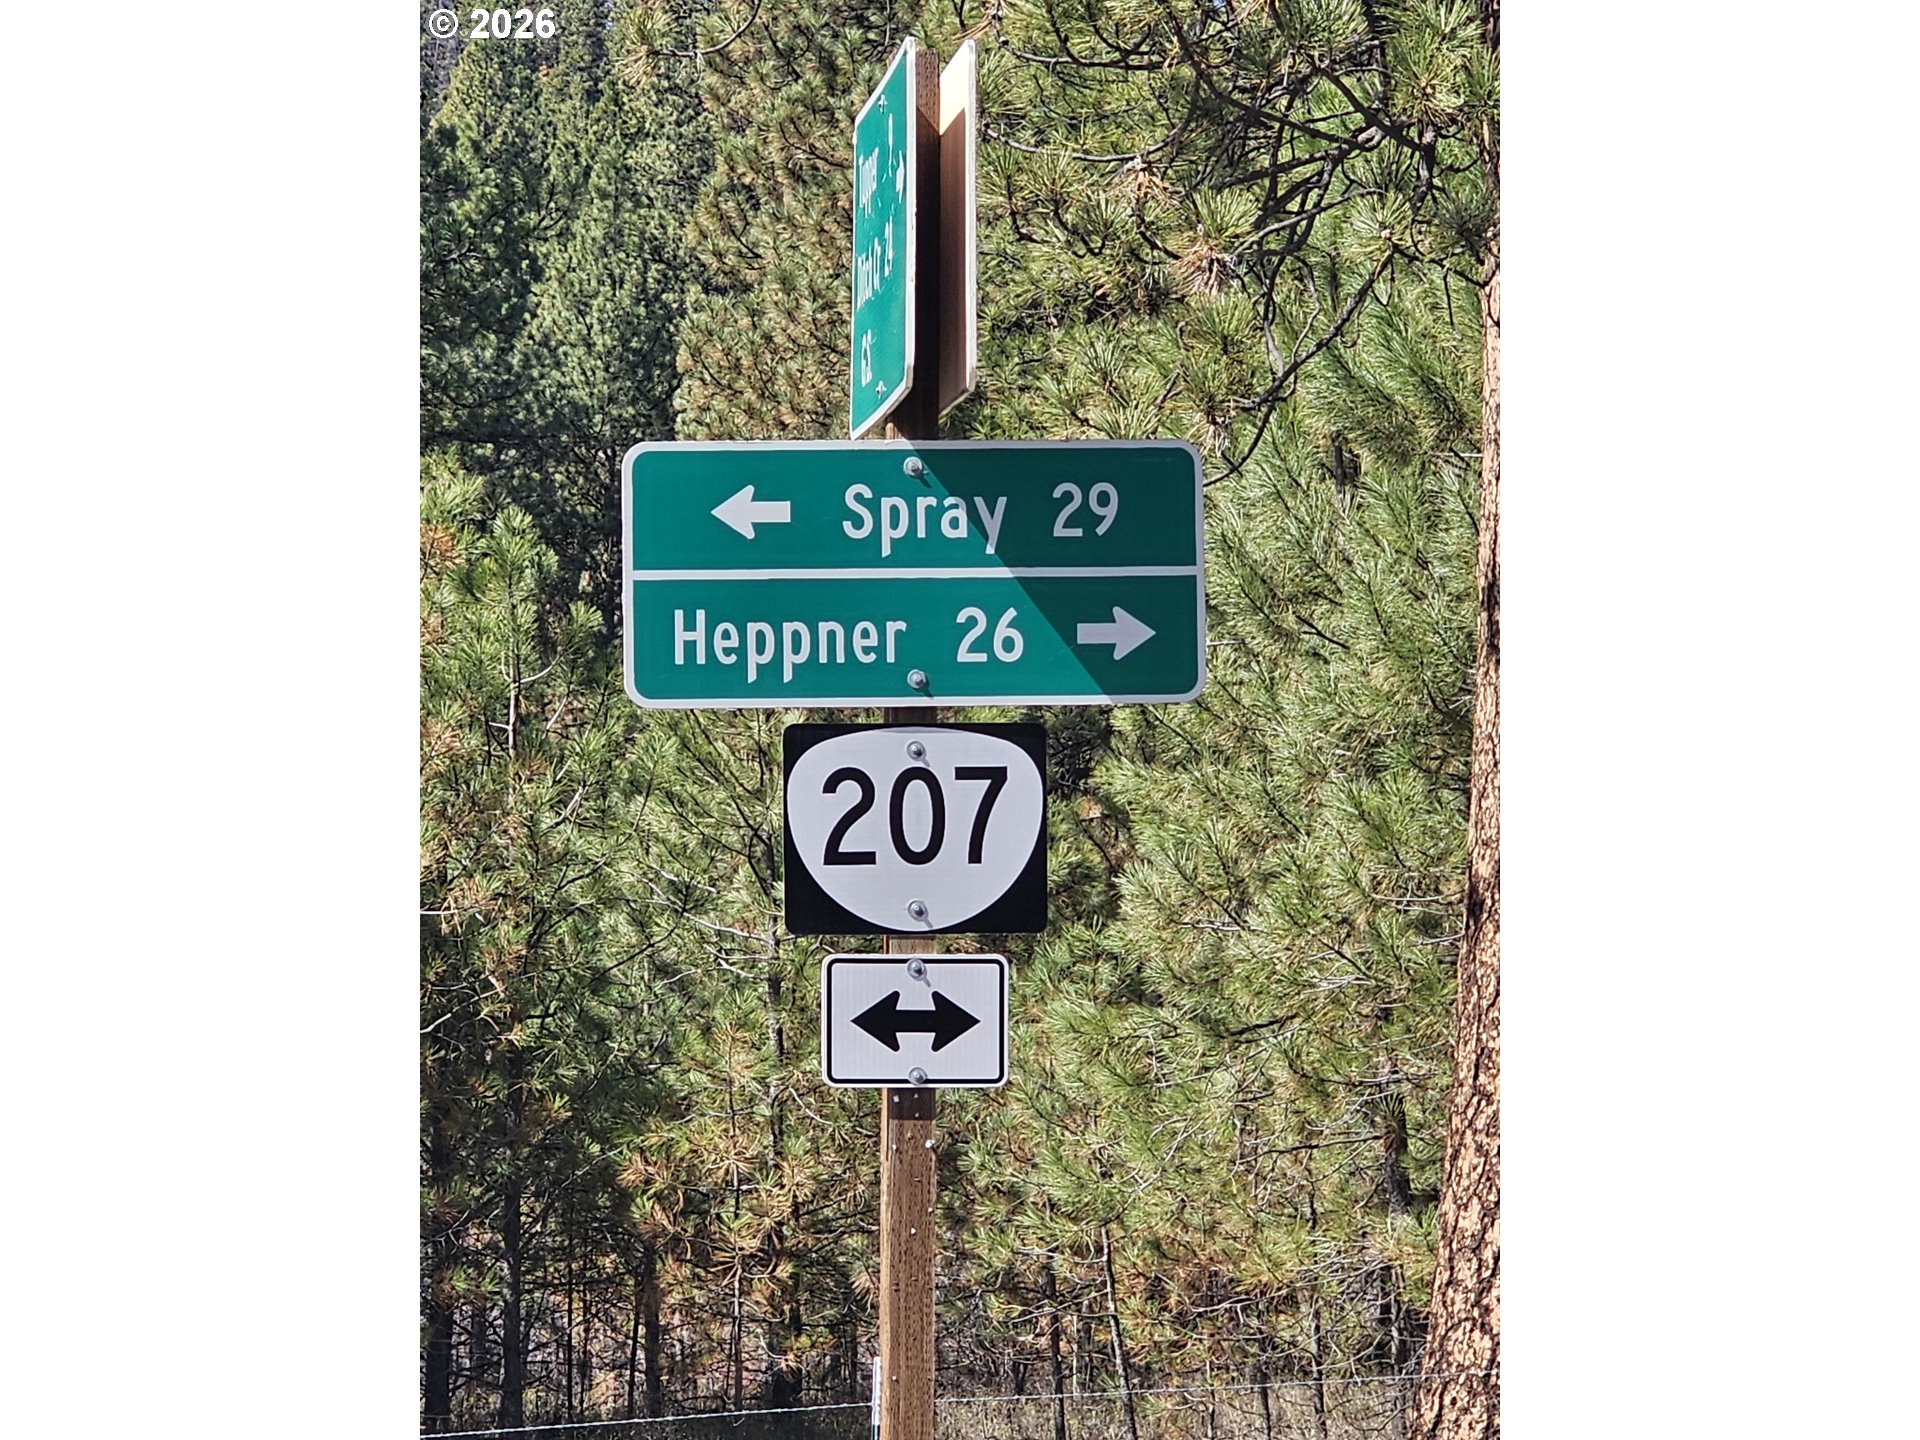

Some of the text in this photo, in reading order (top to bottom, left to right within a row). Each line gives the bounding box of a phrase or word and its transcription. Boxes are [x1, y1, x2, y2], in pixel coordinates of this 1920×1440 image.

[843, 483, 1118, 557] Spray 29
[675, 607, 1023, 684] Heppner 26
[823, 766, 1007, 865] 207
